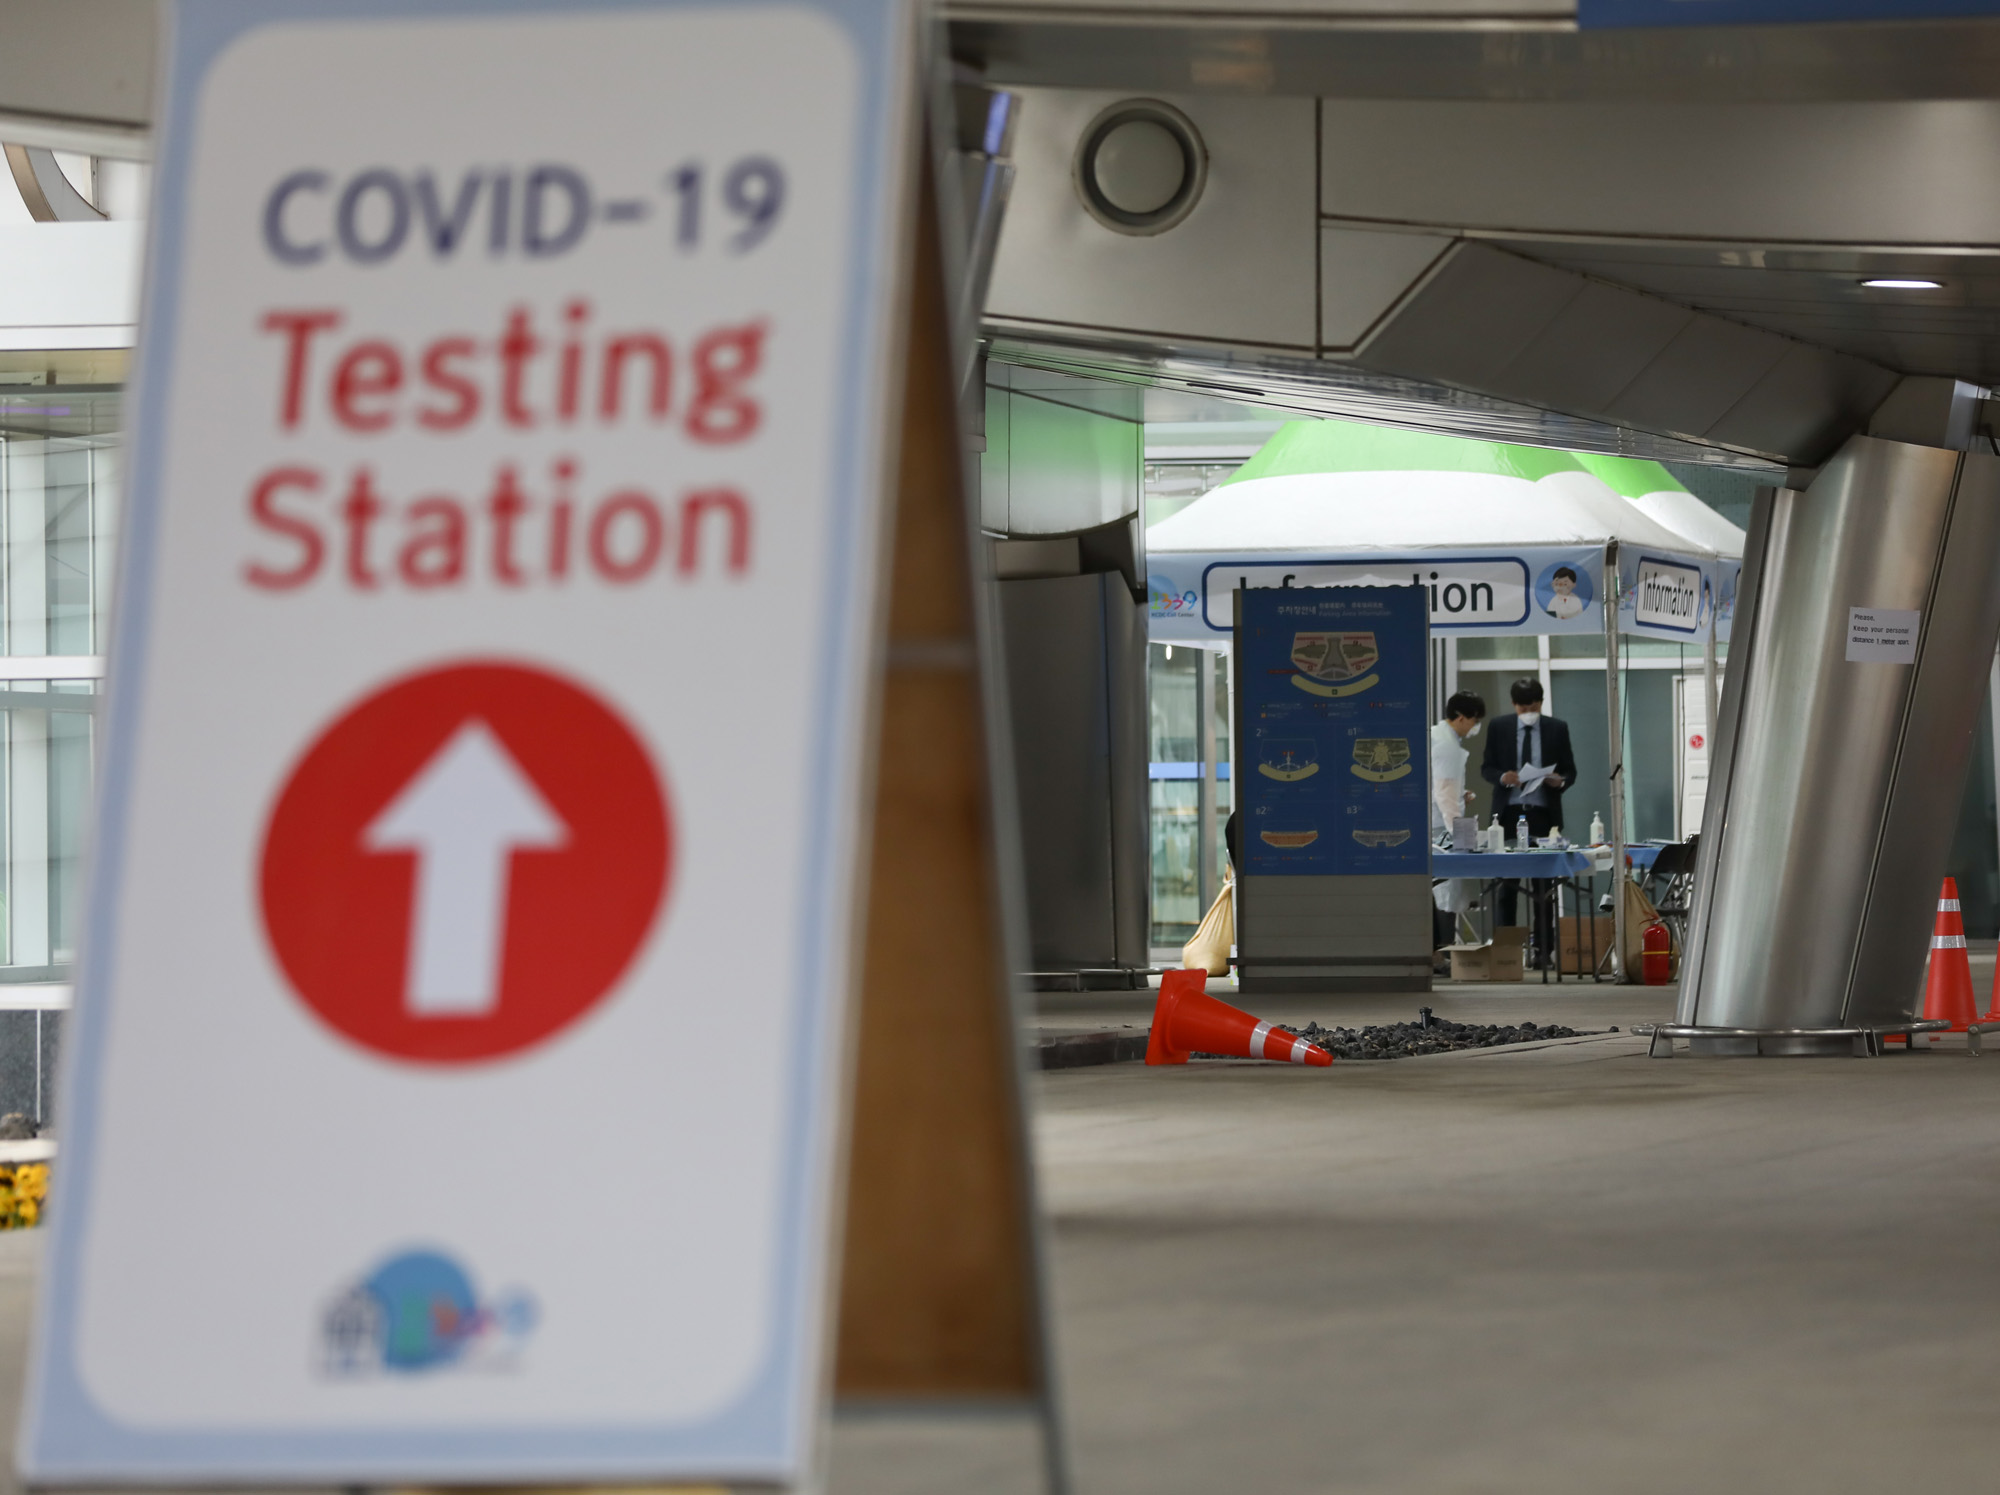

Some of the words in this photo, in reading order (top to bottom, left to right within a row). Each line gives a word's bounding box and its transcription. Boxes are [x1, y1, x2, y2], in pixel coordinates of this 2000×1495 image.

[259, 154, 790, 270] COVID-19
[257, 296, 773, 448] Testing
[240, 456, 755, 594] Station
[1151, 590, 1198, 611] 1339
[1642, 571, 1694, 618] Information
